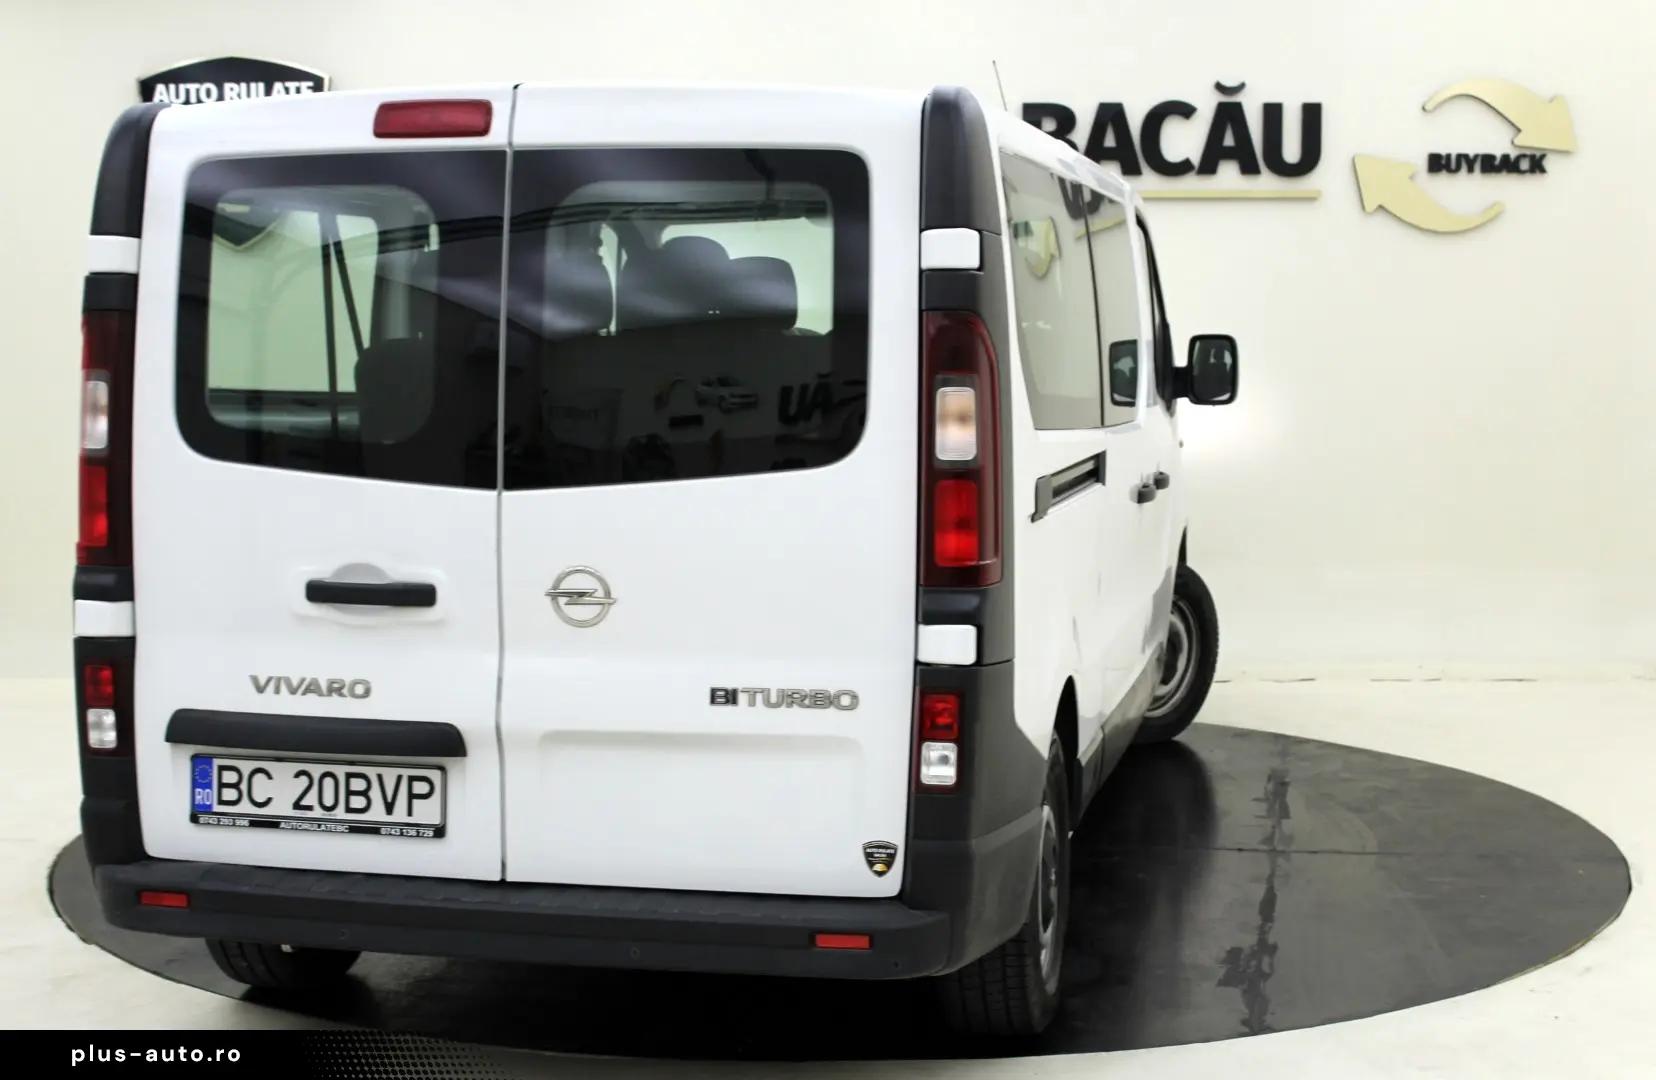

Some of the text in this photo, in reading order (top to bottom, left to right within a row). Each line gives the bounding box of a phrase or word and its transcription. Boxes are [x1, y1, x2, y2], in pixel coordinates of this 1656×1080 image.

[152, 82, 218, 104] AUTO
[1427, 153, 1548, 174] BUYBACK
[249, 674, 372, 699] VIVARO
[194, 788, 212, 805] RO
[217, 764, 435, 817] BC 20BVP
[380, 827, 401, 836] 0743
